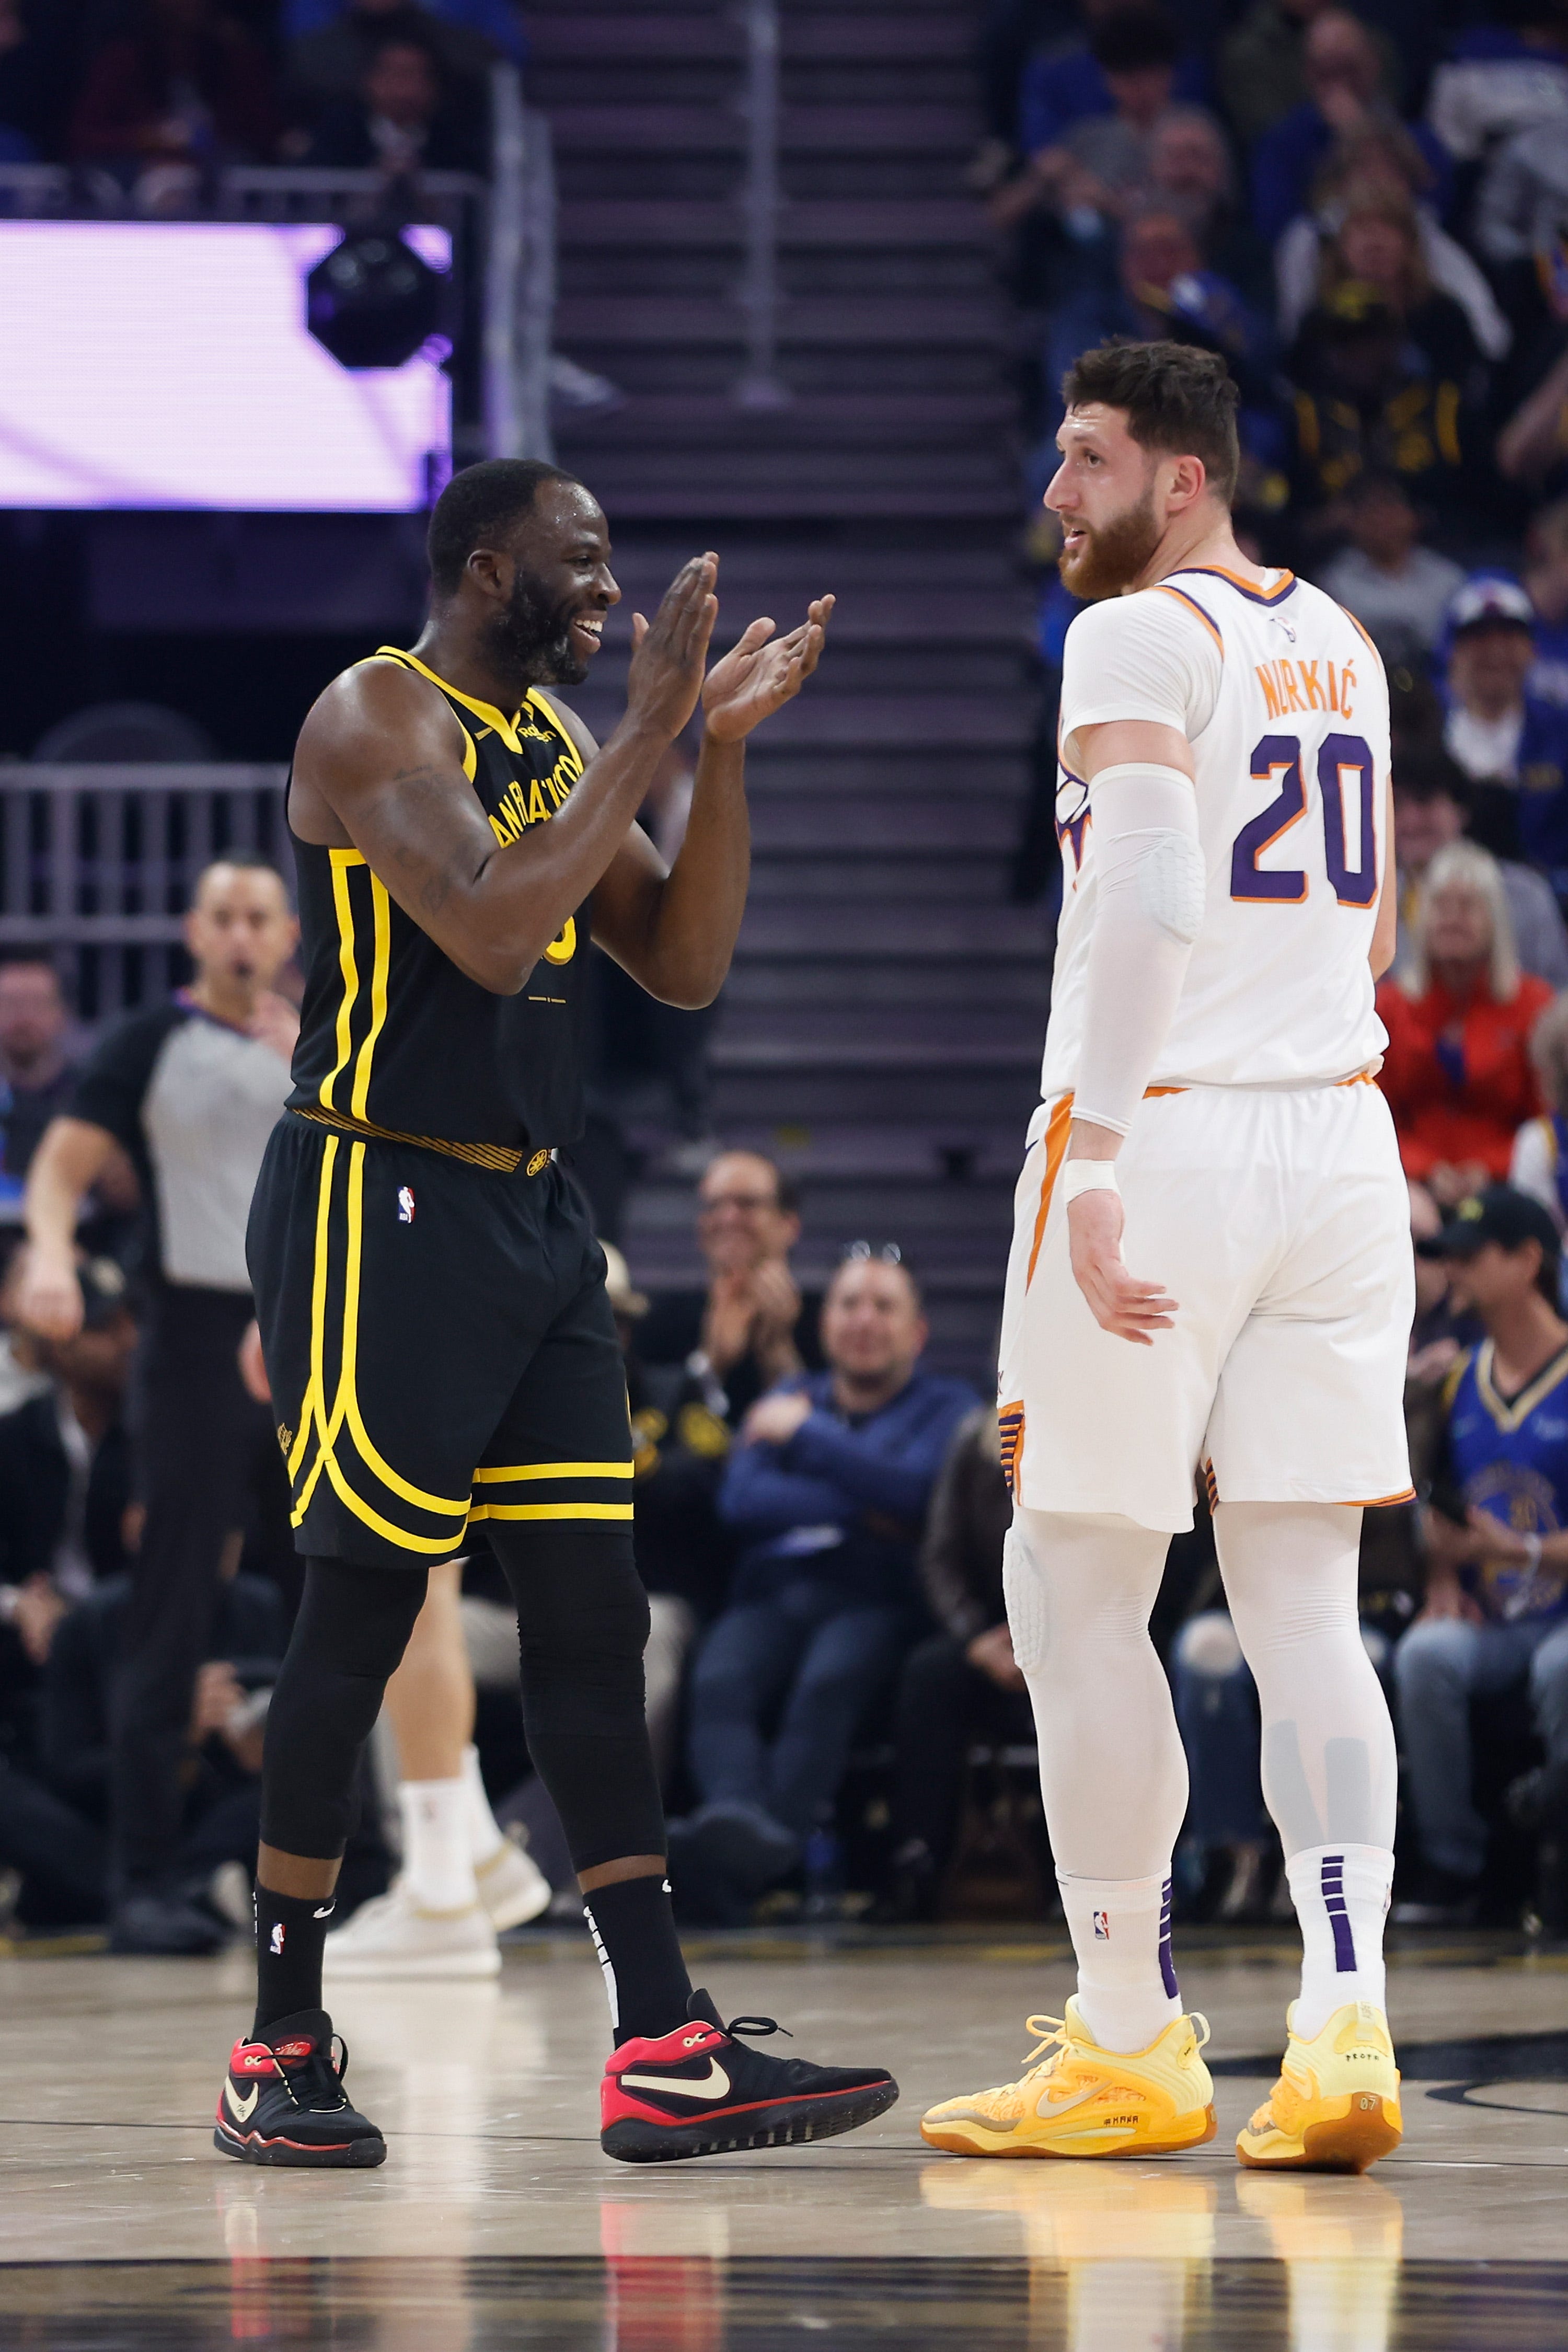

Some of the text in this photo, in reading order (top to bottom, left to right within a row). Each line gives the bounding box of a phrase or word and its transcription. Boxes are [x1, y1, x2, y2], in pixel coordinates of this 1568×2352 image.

[1255, 659, 1356, 720] NURKIĆ
[517, 723, 557, 743] Raen
[1230, 733, 1377, 909] 20
